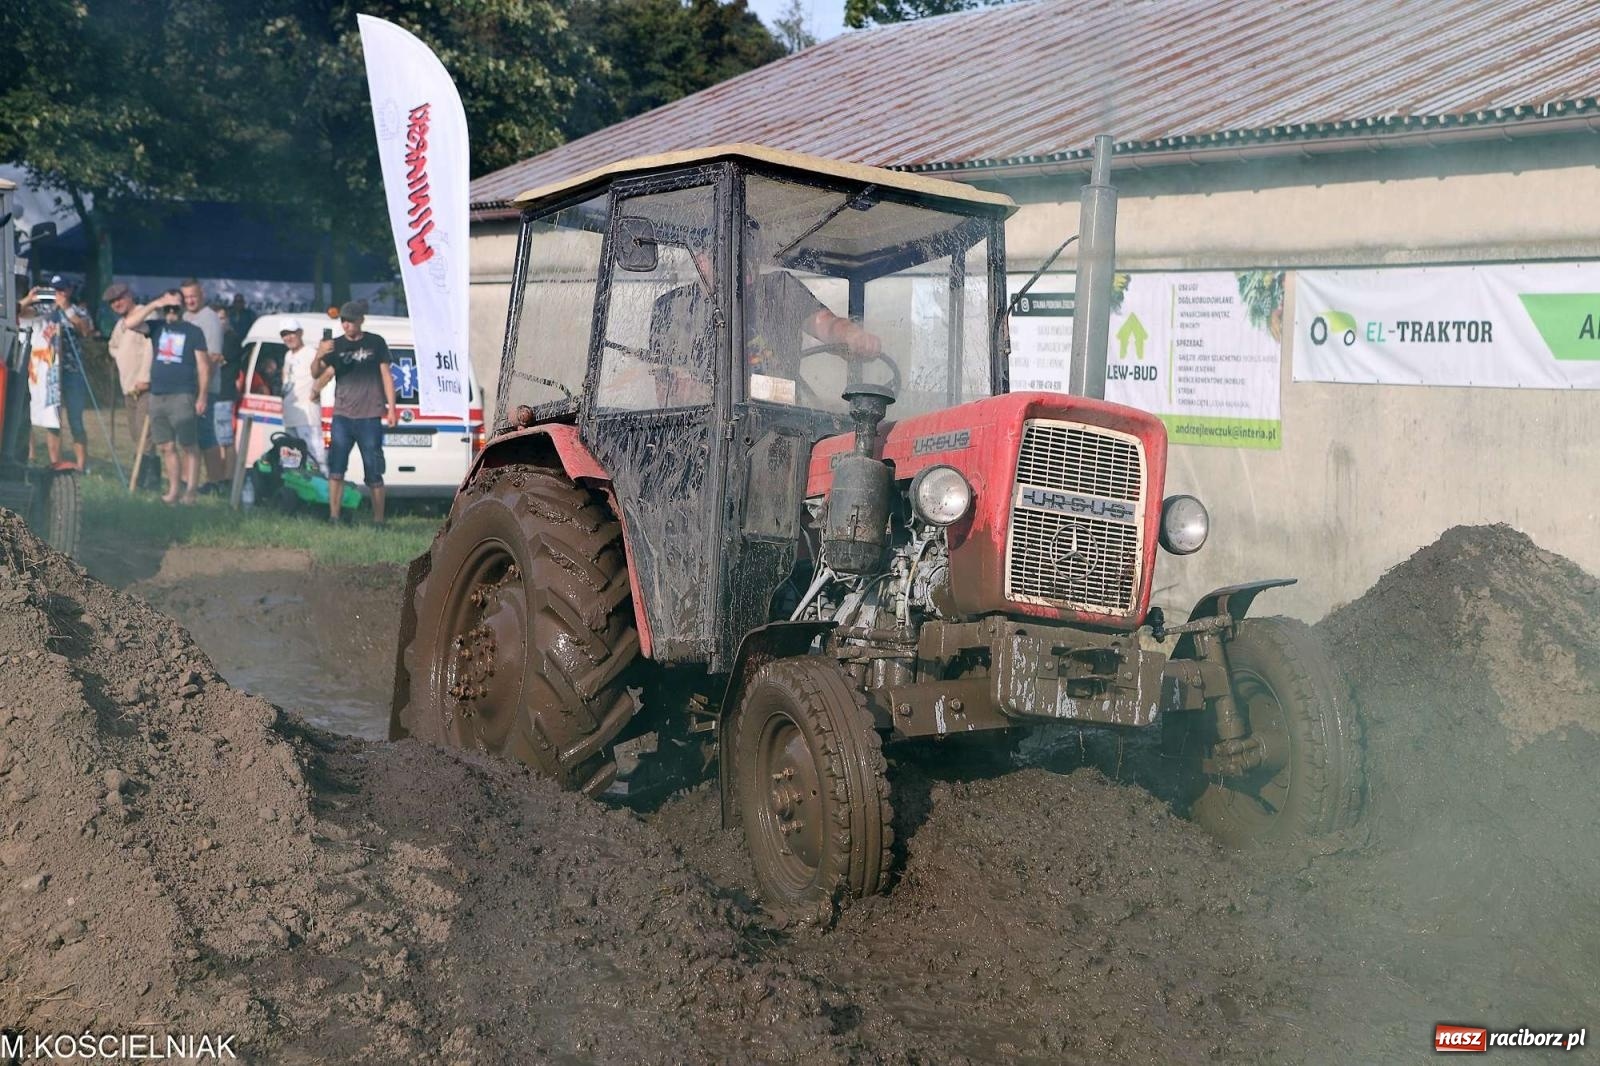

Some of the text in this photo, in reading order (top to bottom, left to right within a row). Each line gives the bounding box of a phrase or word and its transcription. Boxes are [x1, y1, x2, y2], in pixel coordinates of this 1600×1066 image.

[1366, 320, 1493, 343] EL-TRAKTOR
[1578, 313, 1600, 340] A
[1107, 364, 1158, 382] LEW-BUD
[915, 431, 969, 453] URSUS
[1176, 423, 1276, 441] andrzejlewczuk@interia.pl
[1023, 490, 1133, 519] URSUS
